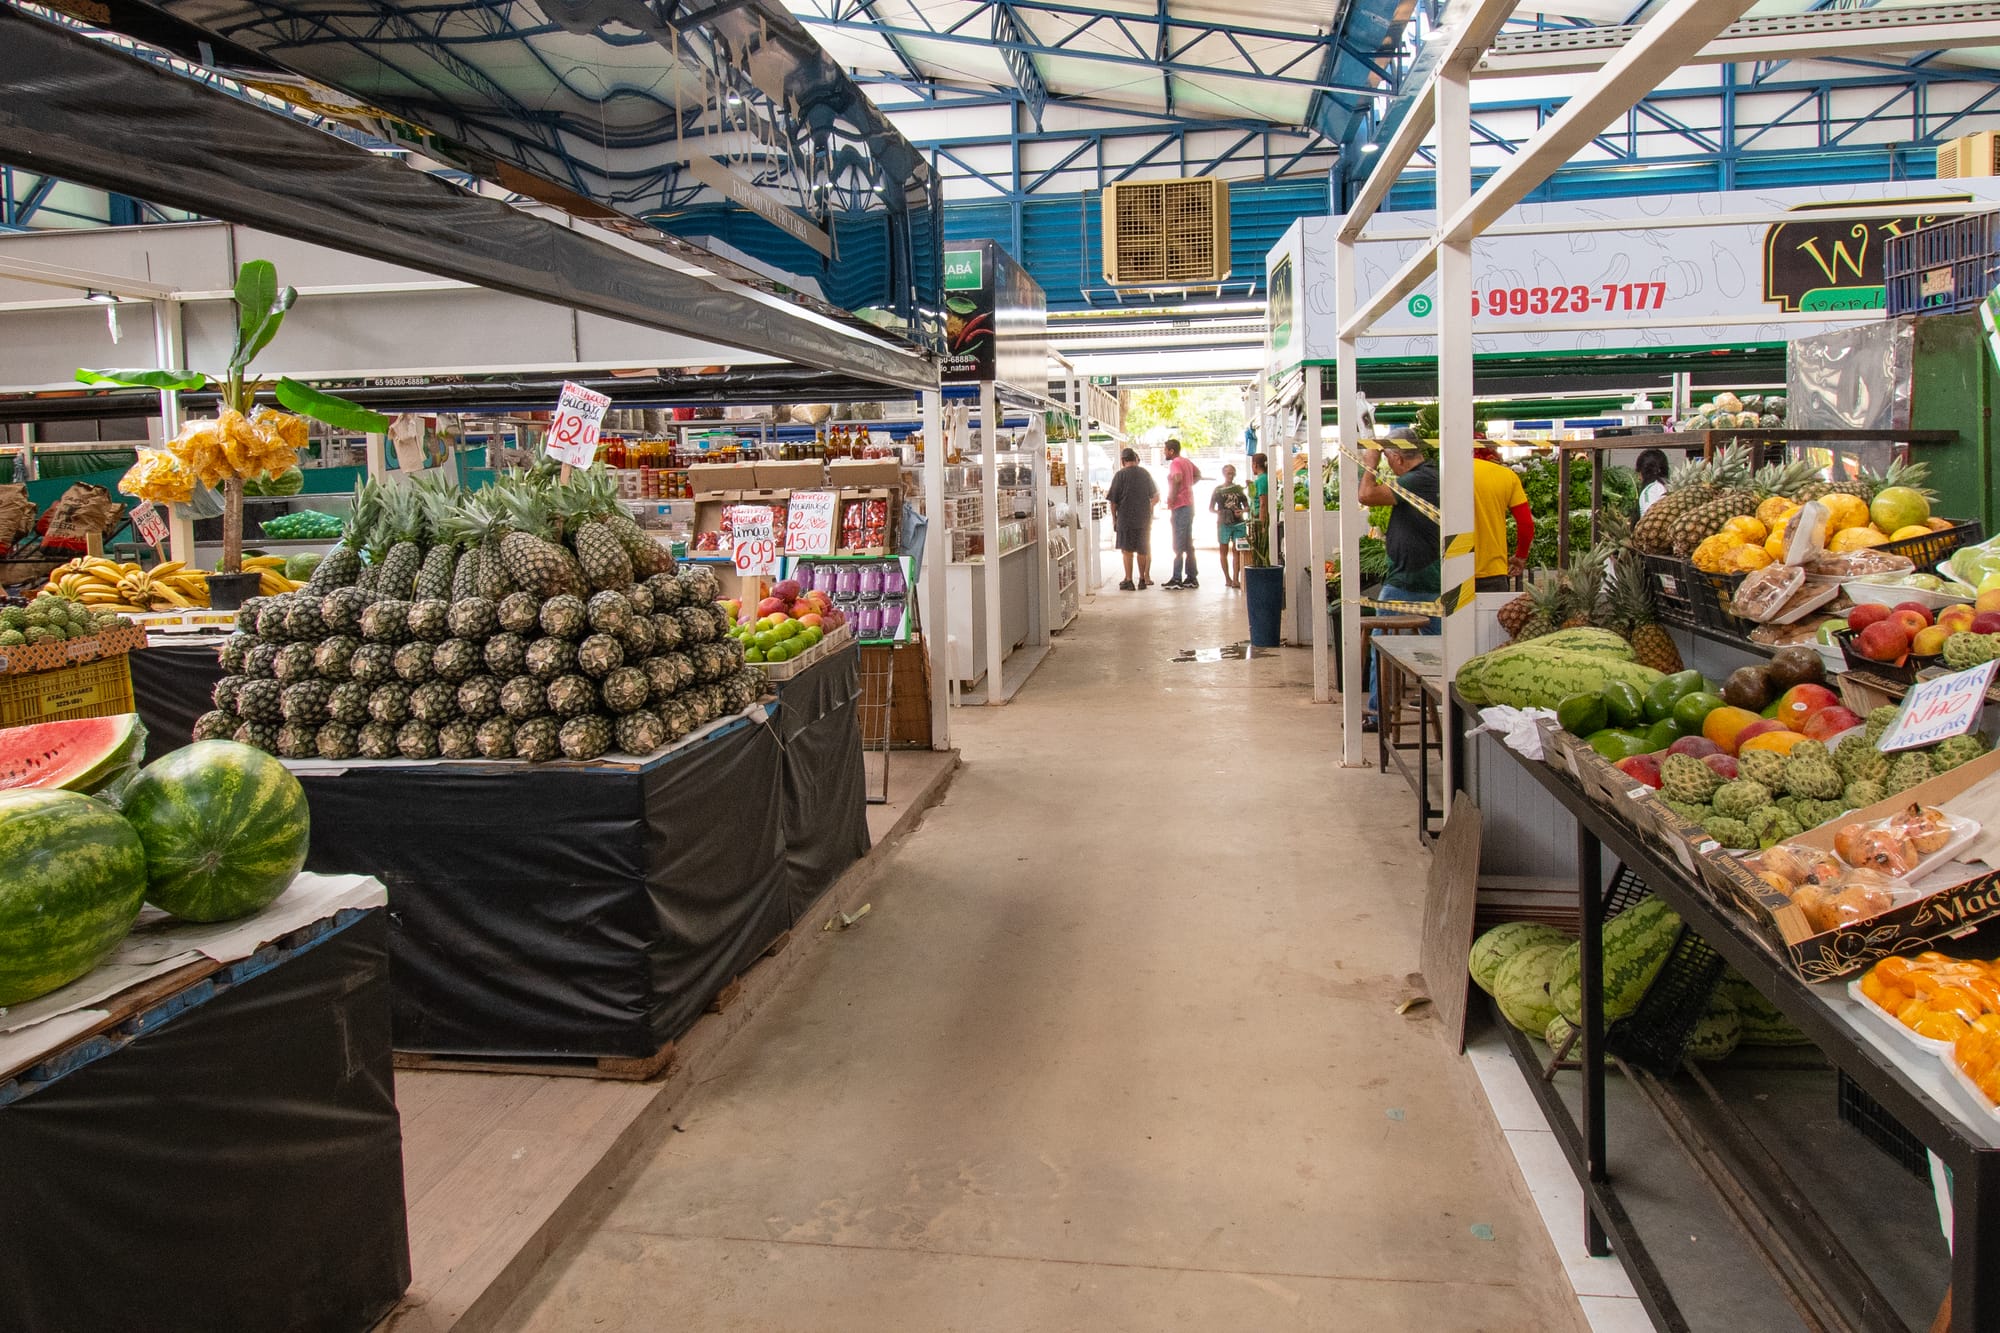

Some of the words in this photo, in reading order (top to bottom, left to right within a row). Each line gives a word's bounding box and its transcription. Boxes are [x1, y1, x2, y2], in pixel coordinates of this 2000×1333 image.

[777, 207, 808, 240] FRUTARIA
[1488, 282, 1667, 317] 99323-7177
[1808, 291, 1887, 312] verd
[1912, 668, 1986, 709] FAVOR
